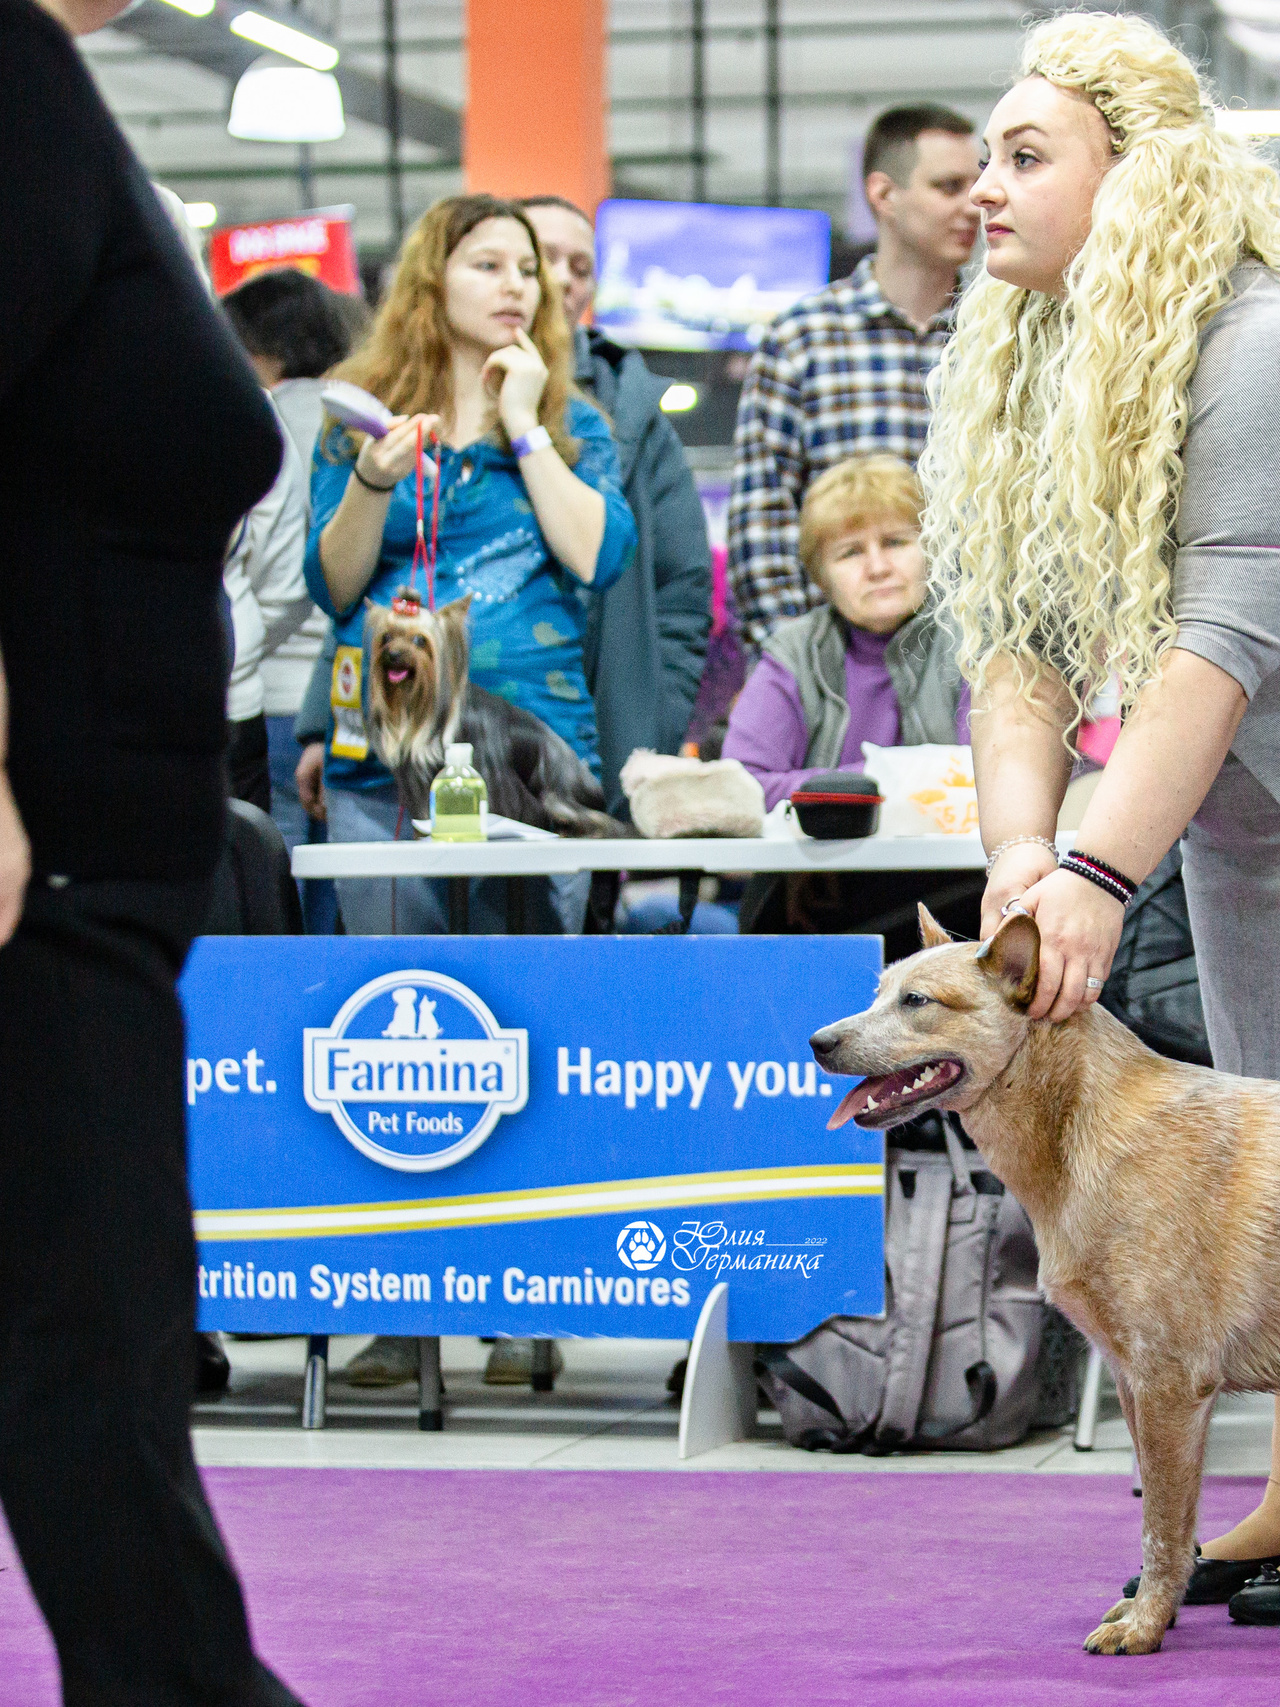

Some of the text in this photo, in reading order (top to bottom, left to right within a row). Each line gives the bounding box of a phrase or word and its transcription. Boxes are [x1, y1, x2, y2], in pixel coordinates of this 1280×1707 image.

[187, 1047, 277, 1106] pet.
[327, 1047, 504, 1092] Farmina
[557, 1046, 832, 1110] Happy you.
[368, 1110, 464, 1134] Pet Foods
[198, 1261, 692, 1310] trition System for Carnivores
